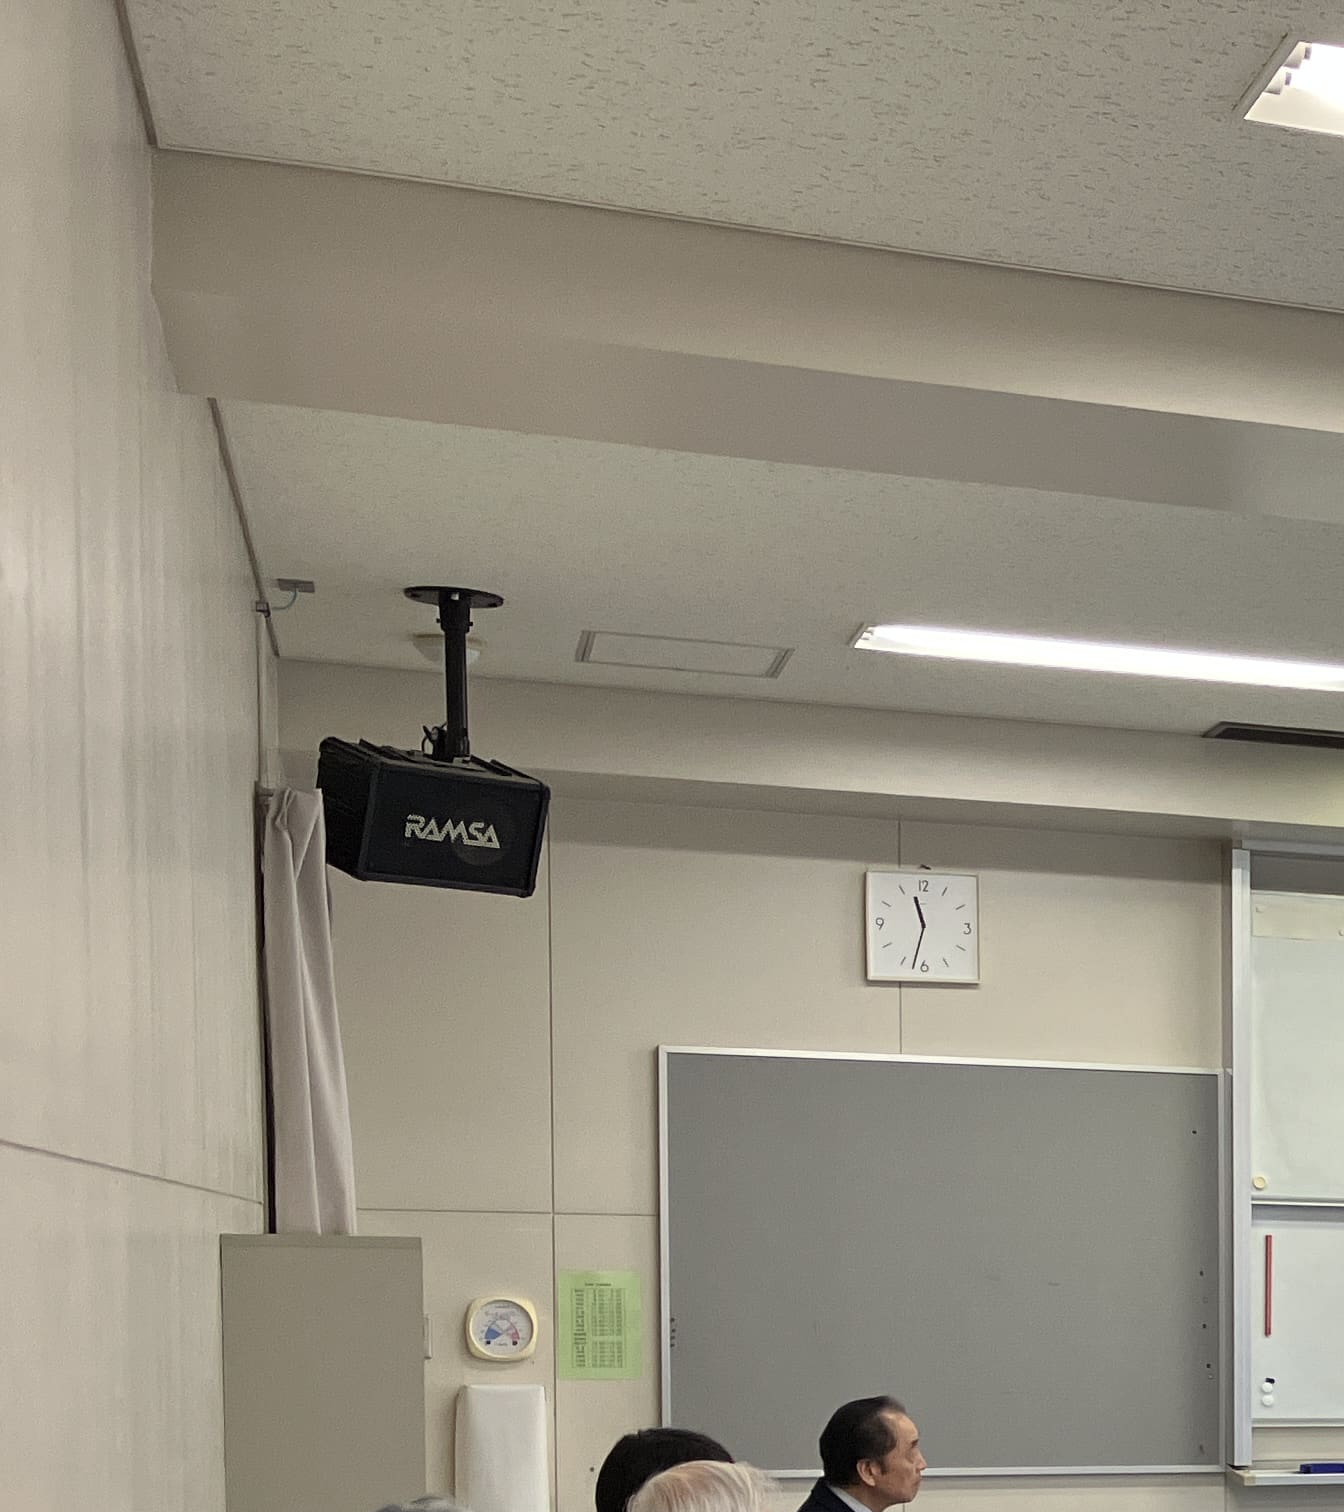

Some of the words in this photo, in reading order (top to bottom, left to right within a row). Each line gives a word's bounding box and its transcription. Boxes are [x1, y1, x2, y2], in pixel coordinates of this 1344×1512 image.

[404, 814, 500, 849] RAMSA
[918, 879, 929, 892] 12
[875, 917, 884, 930] 9
[963, 922, 972, 935] 3
[920, 960, 929, 972] 6
